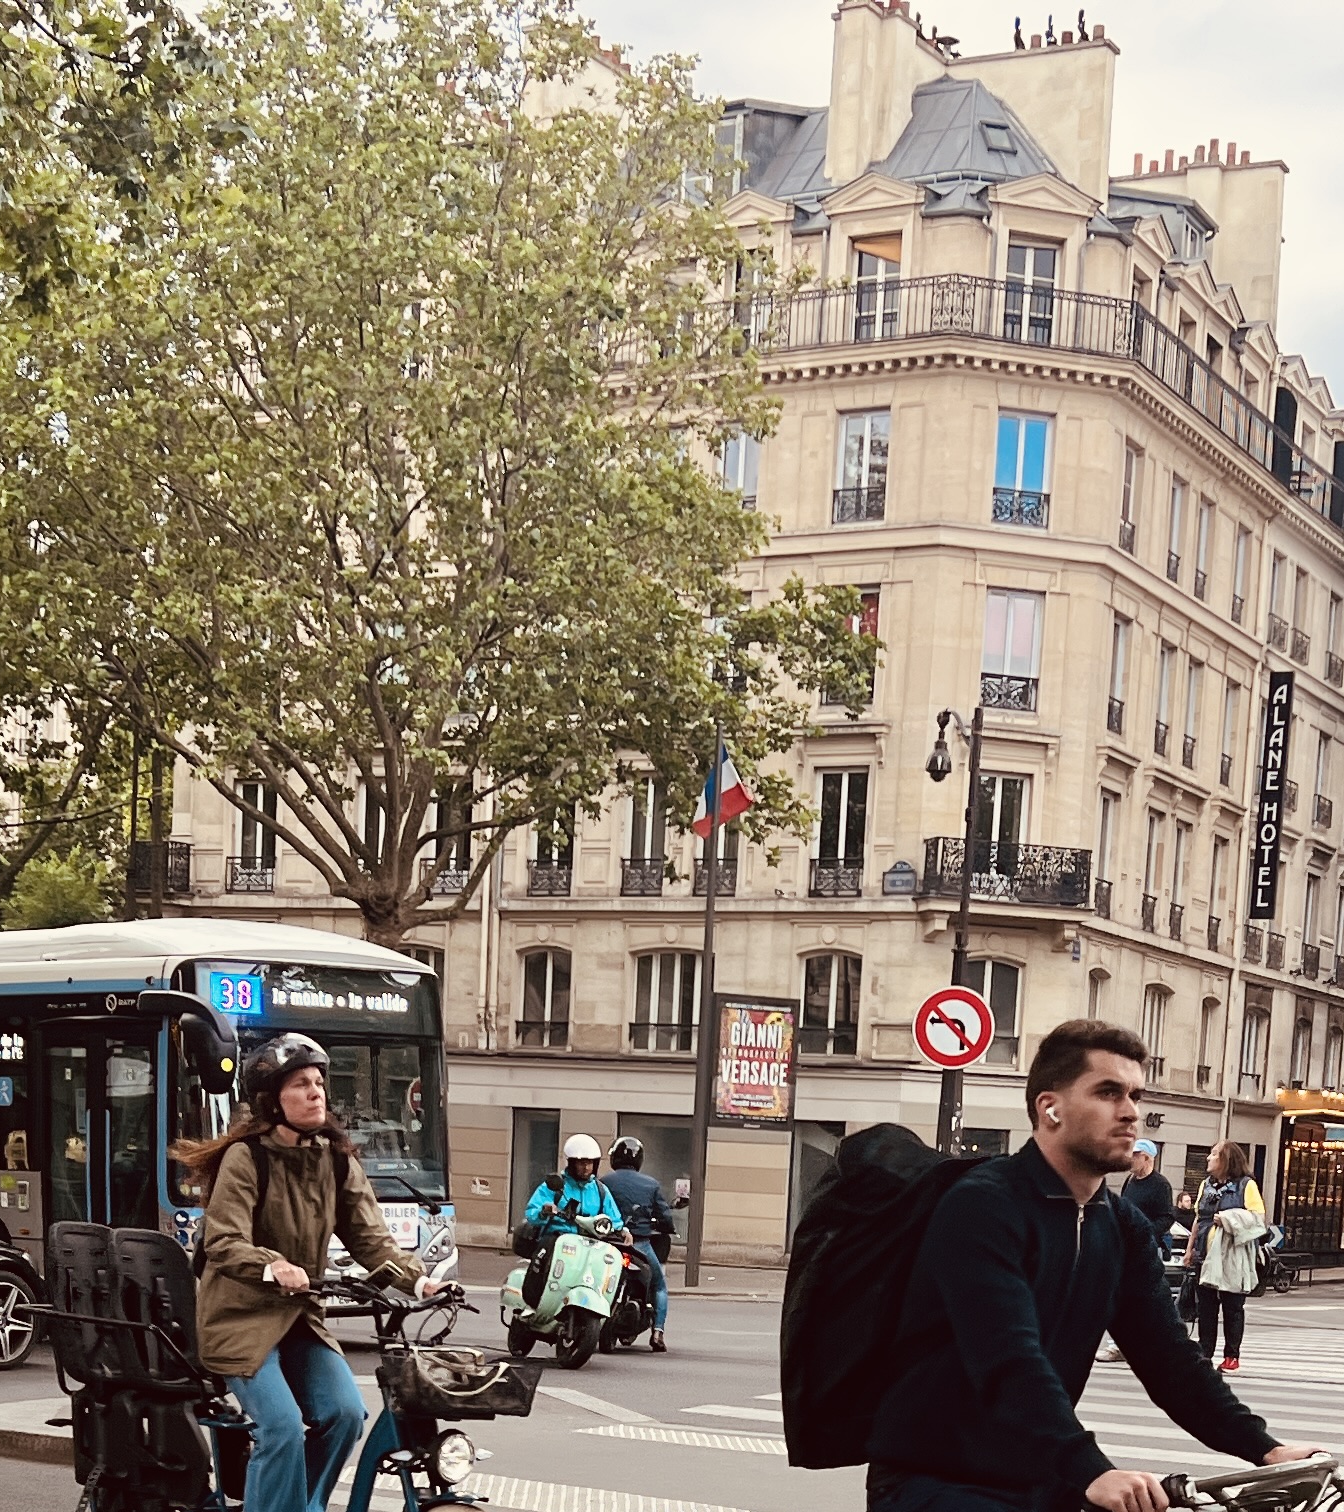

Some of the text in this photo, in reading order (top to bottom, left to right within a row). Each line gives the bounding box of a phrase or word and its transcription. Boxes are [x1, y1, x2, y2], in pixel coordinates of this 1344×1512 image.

[1256, 683, 1288, 907] ALANE HOTEL
[220, 977, 252, 1010] 38
[290, 989, 335, 1009] monte
[365, 992, 409, 1013] valide
[730, 1021, 783, 1050] GIANNI
[721, 1058, 789, 1088] VERSACE
[384, 1207, 417, 1218] BILIER
